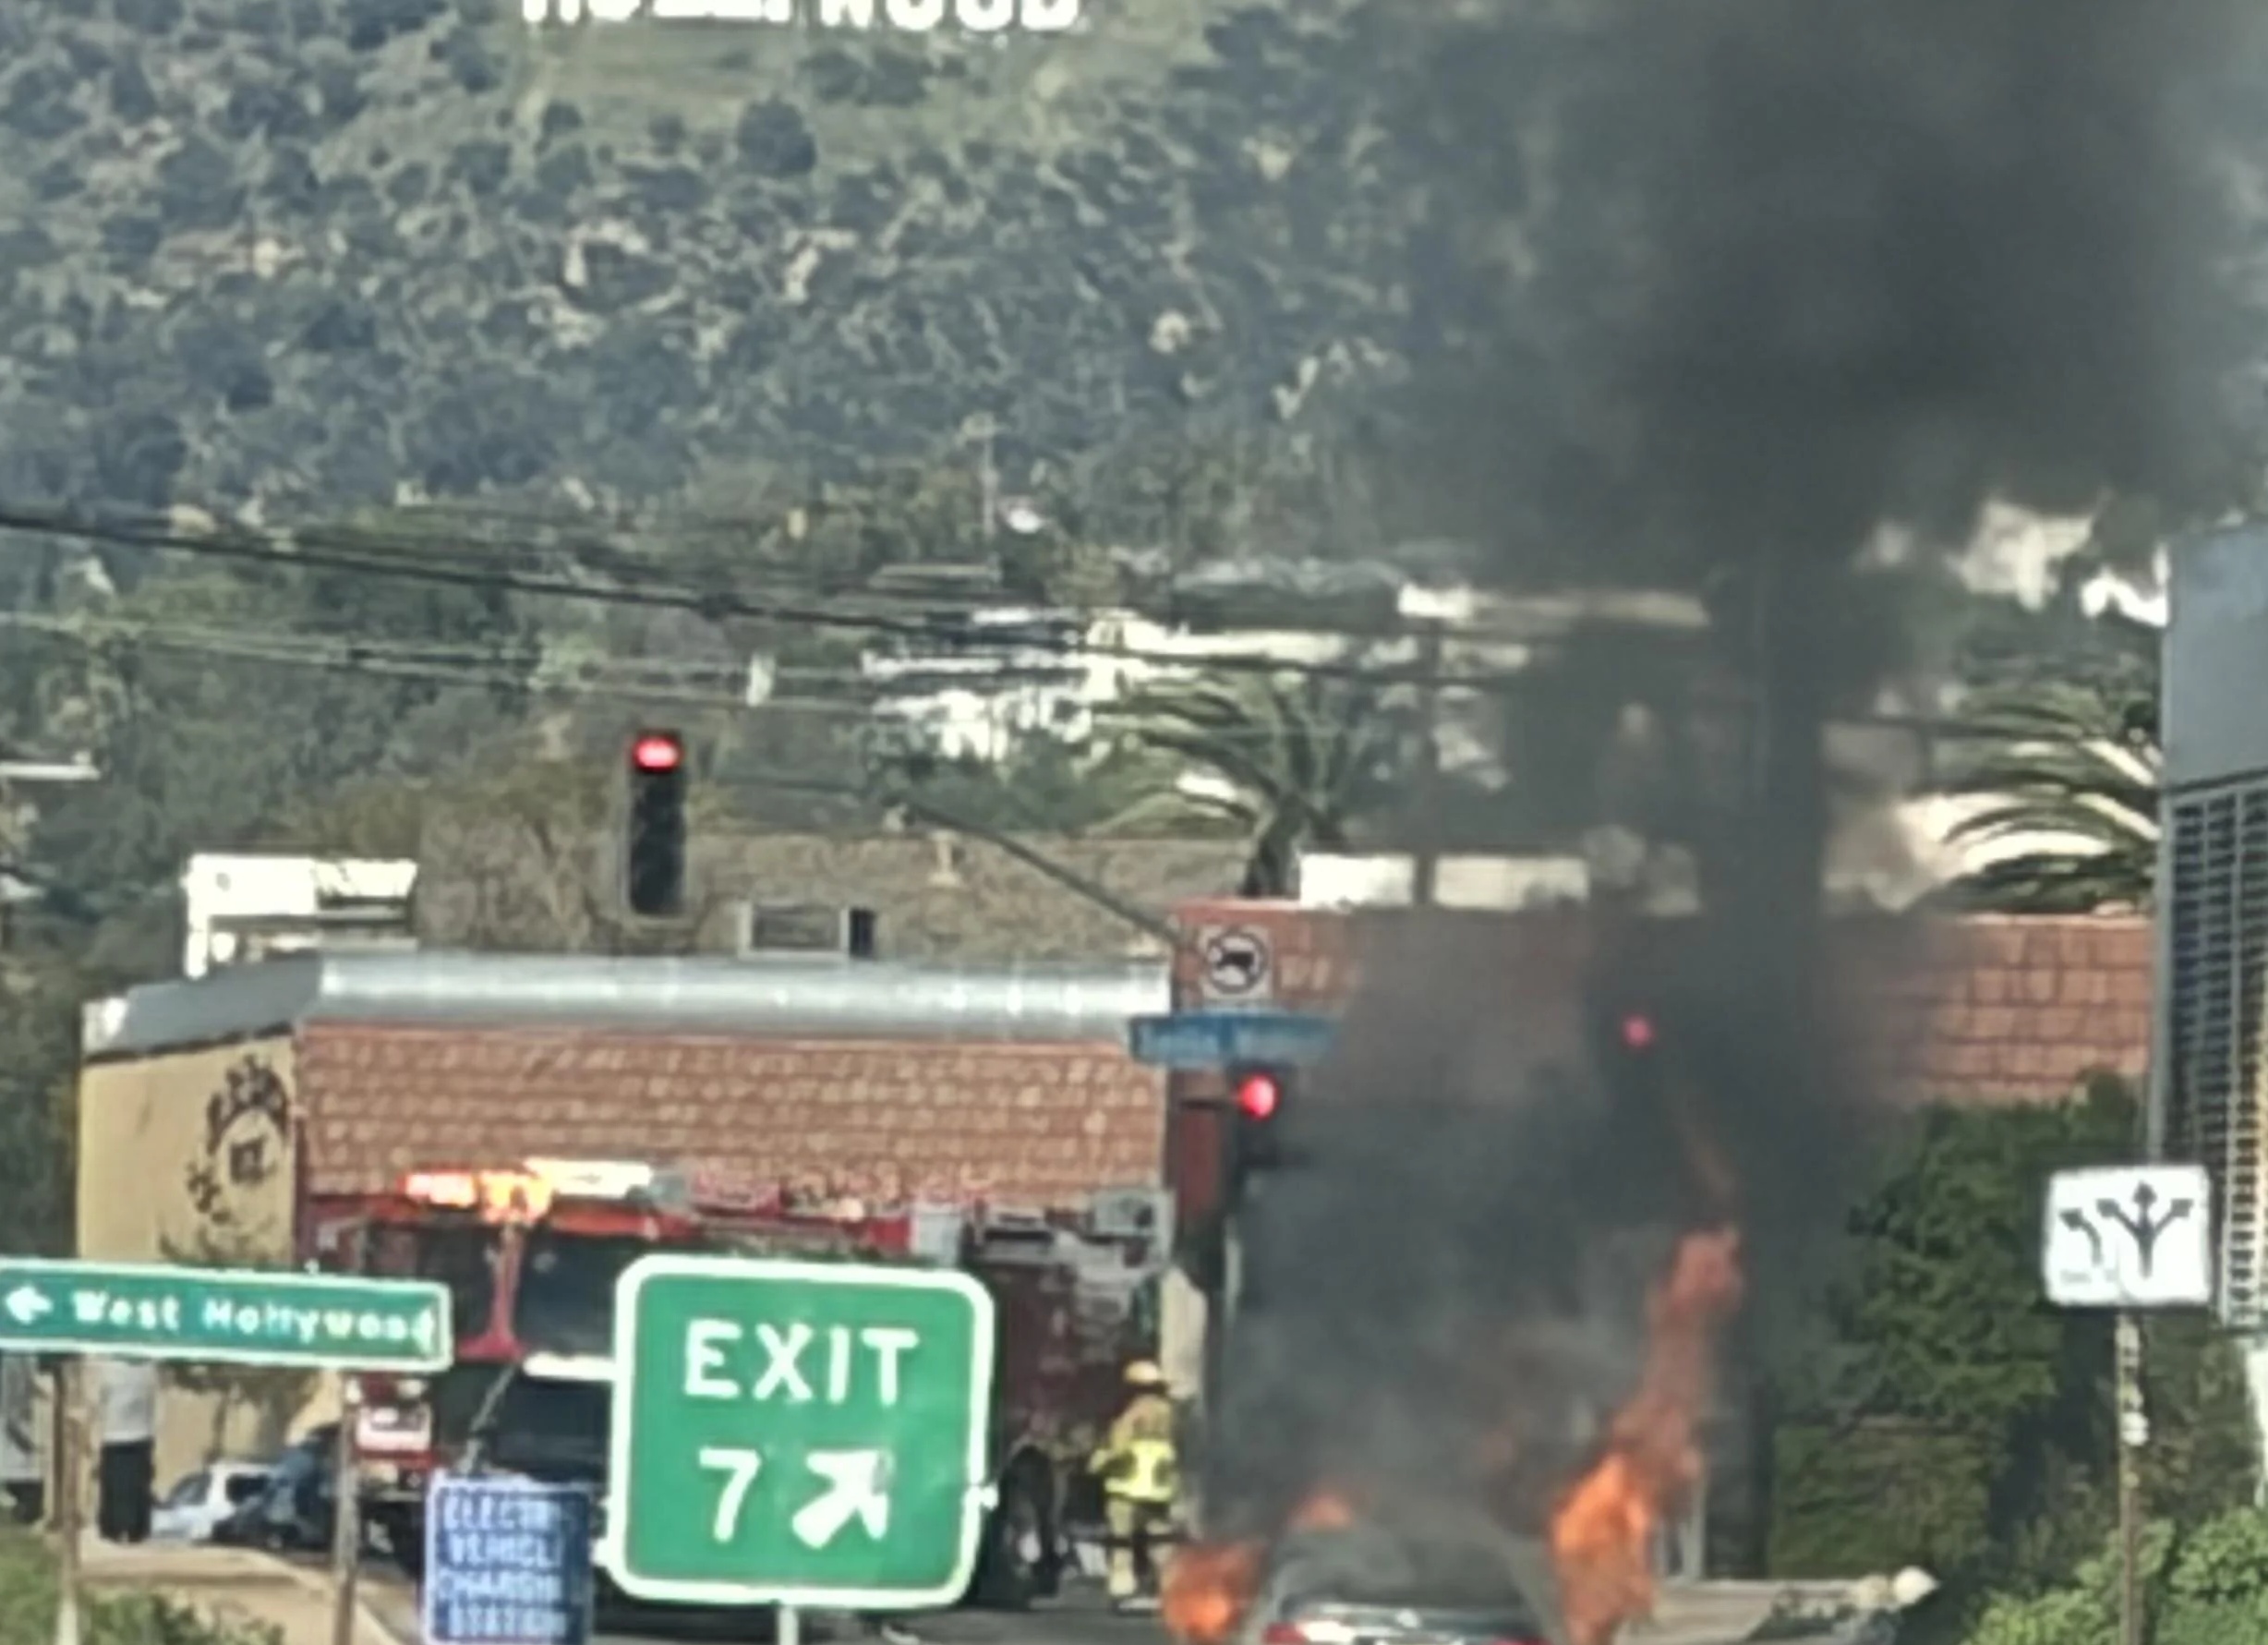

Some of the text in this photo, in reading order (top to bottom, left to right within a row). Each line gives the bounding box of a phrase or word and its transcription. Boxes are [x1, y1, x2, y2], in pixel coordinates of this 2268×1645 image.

[72, 1290, 180, 1332] West
[684, 1318, 920, 1407] EXIT
[698, 1445, 762, 1542] 7
